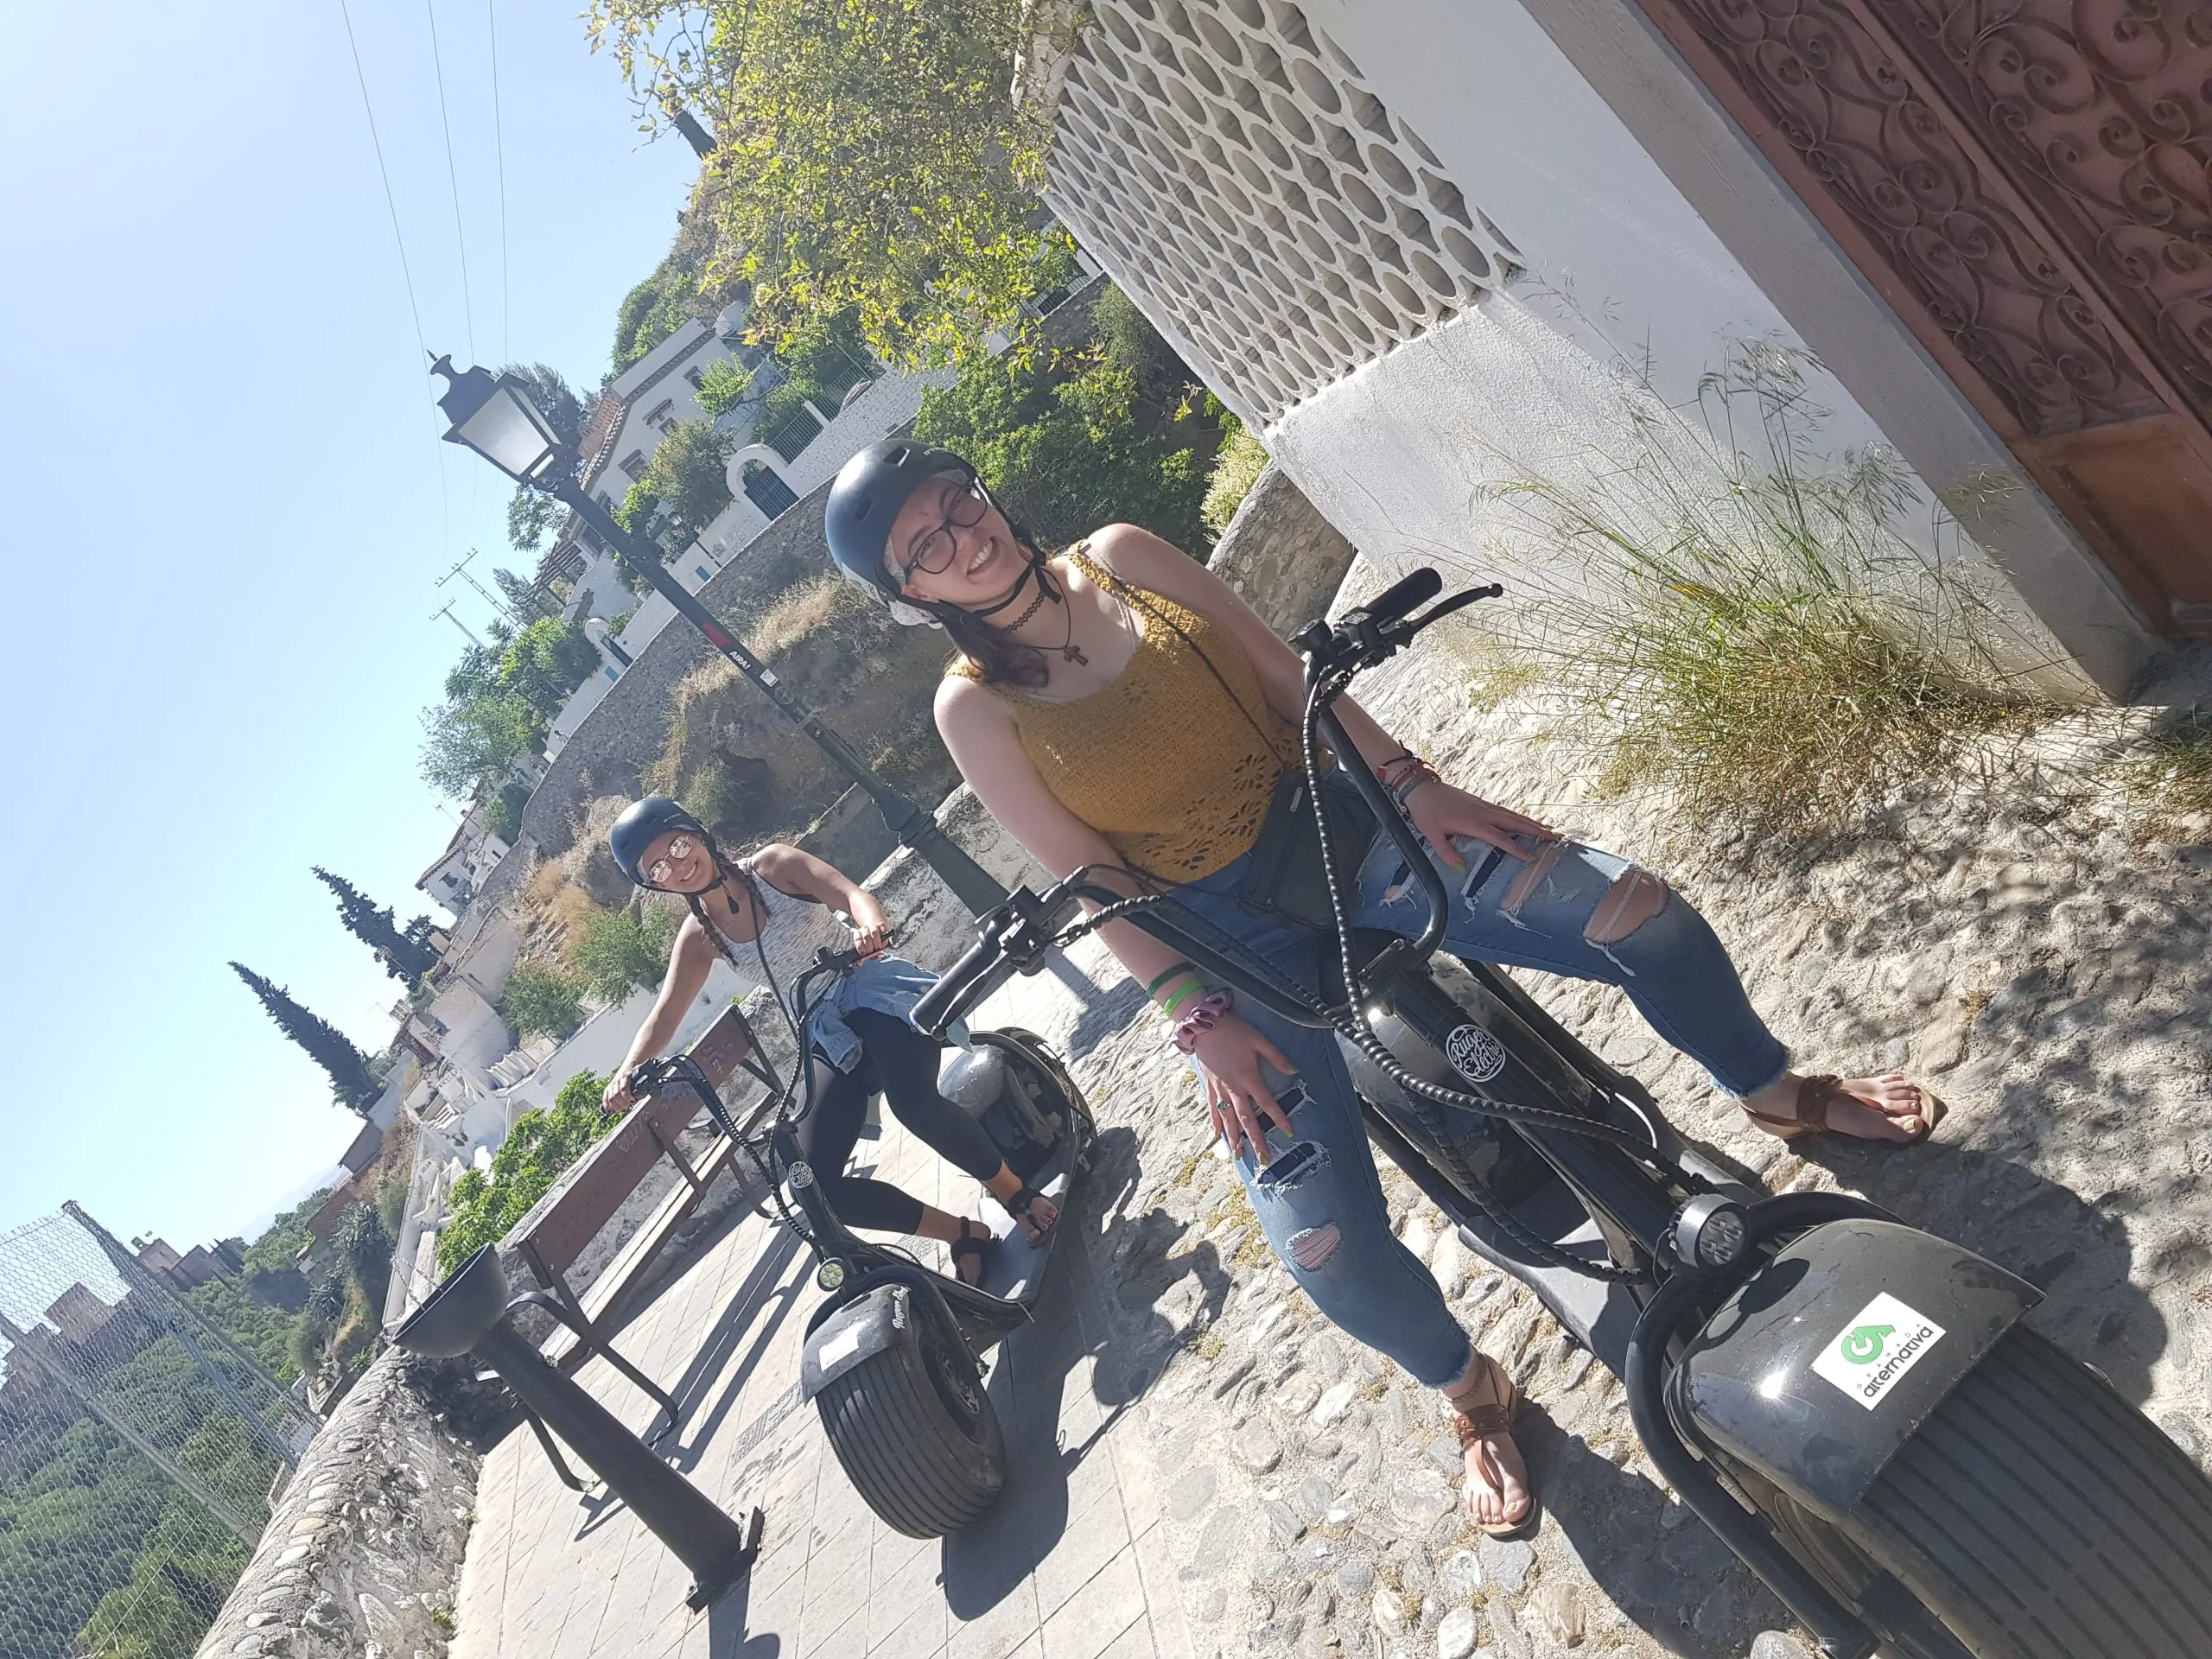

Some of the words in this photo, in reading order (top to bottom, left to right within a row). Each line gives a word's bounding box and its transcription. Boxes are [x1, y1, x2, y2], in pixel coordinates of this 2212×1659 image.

[1451, 1028, 1491, 1069] Ruger
[1463, 1041, 1501, 1077] Electric
[892, 1300, 906, 1330] Ruger
[1856, 1323, 1921, 1389] GRANADA
[1863, 1325, 1935, 1398] alternativa
